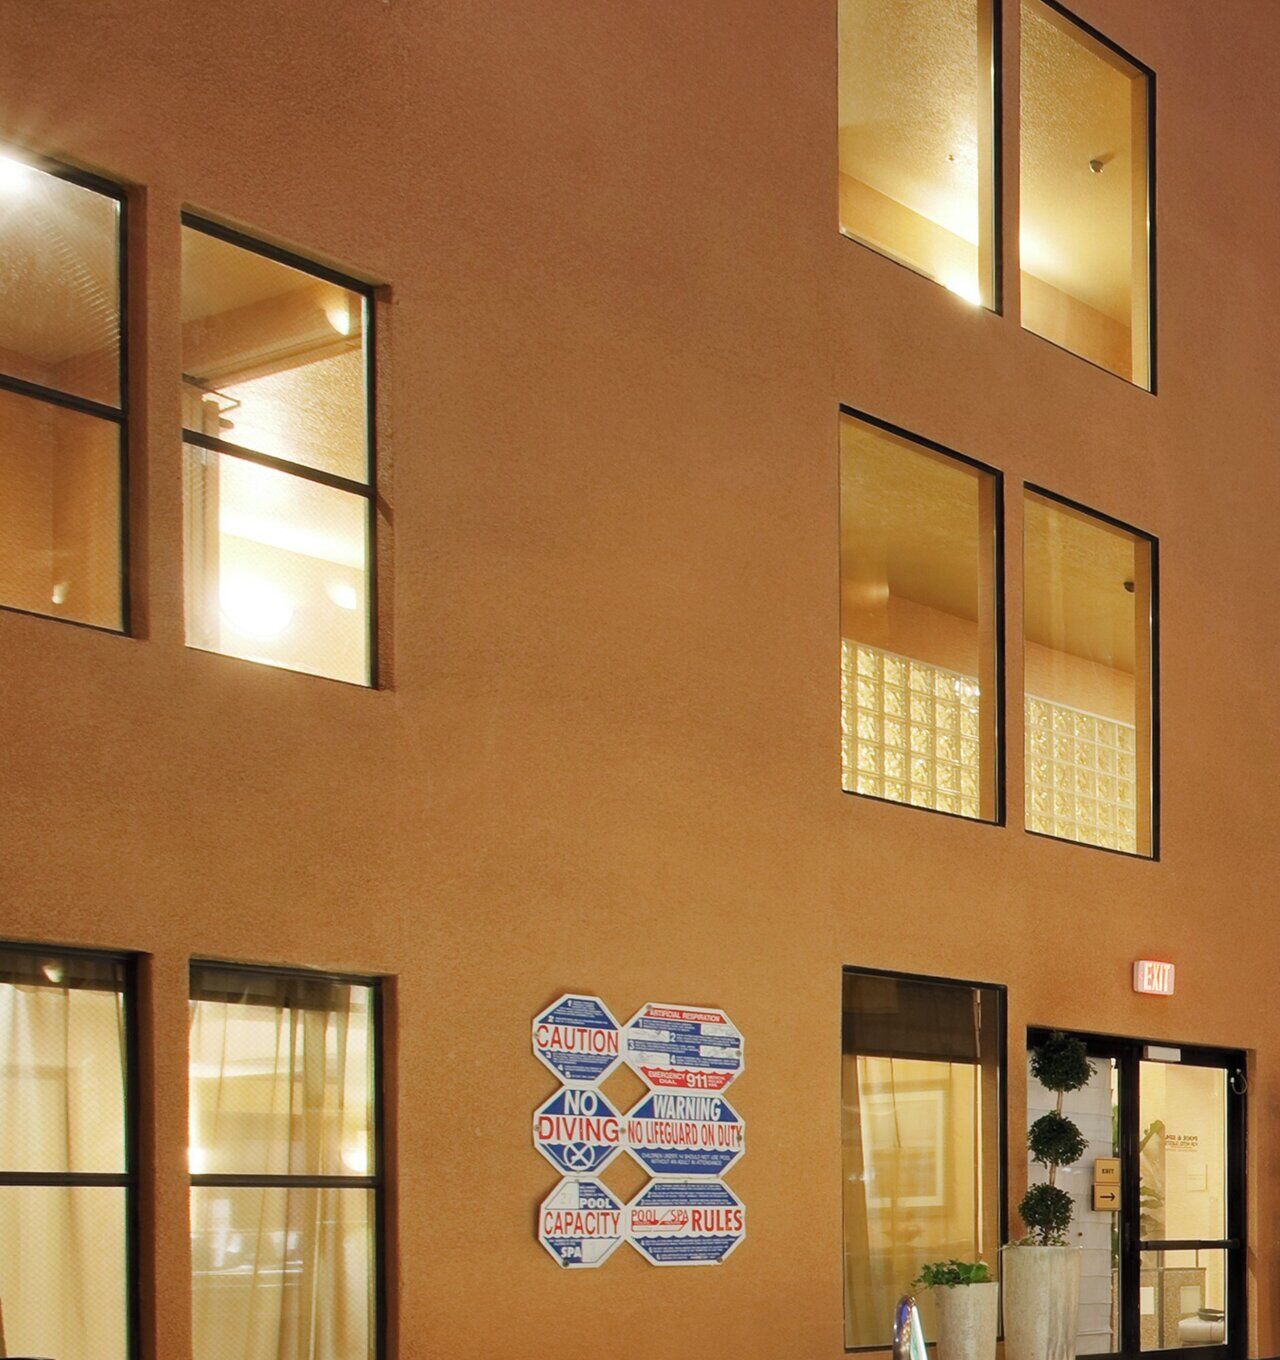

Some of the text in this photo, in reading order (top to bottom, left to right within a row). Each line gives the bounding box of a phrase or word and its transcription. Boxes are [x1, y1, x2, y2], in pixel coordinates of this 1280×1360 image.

[1144, 962, 1170, 992] EXIT
[536, 1024, 618, 1053] CAUTION
[687, 1073, 708, 1088] 911
[564, 1090, 598, 1116] NO
[654, 1095, 721, 1121] WARNING
[539, 1116, 620, 1142] DIVING
[628, 1121, 742, 1148] NO LIFEGUARD ON DUTY
[580, 1198, 612, 1209] POOL
[544, 1211, 621, 1235] CAPACITY
[631, 1209, 742, 1231] POOL SPA RULES
[561, 1246, 582, 1258] SPA
